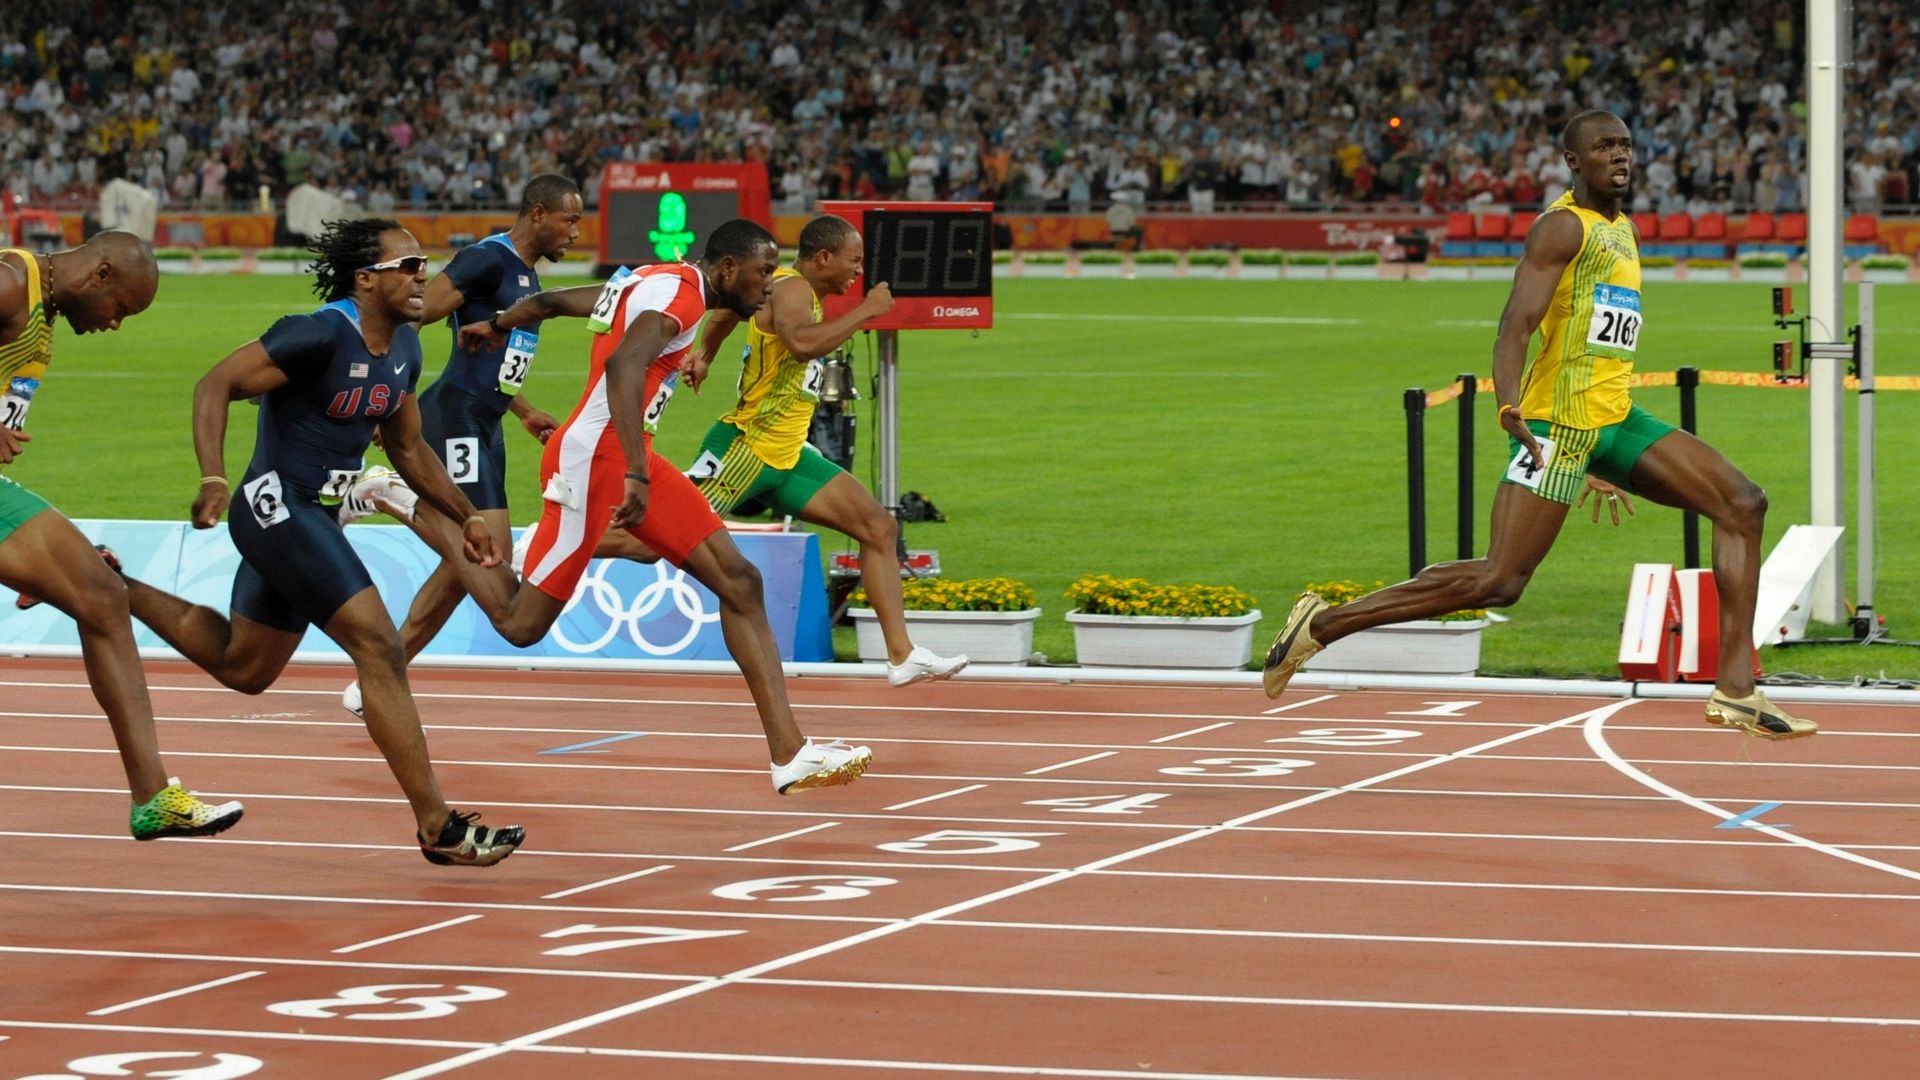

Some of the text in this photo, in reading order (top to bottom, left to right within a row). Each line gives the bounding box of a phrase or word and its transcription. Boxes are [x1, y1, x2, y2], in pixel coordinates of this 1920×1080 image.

[658, 171, 671, 188] A
[1597, 311, 1639, 347] 2163
[453, 443, 471, 479] 3
[1516, 443, 1545, 480] 4
[252, 478, 277, 523] 6
[1385, 701, 1483, 716] 1
[1264, 727, 1424, 747] 2
[1158, 757, 1316, 776] 3
[1022, 793, 1173, 814] 4
[876, 830, 1068, 855] 5
[711, 875, 899, 901] 6
[540, 923, 749, 956] 7
[266, 984, 508, 1021] 8
